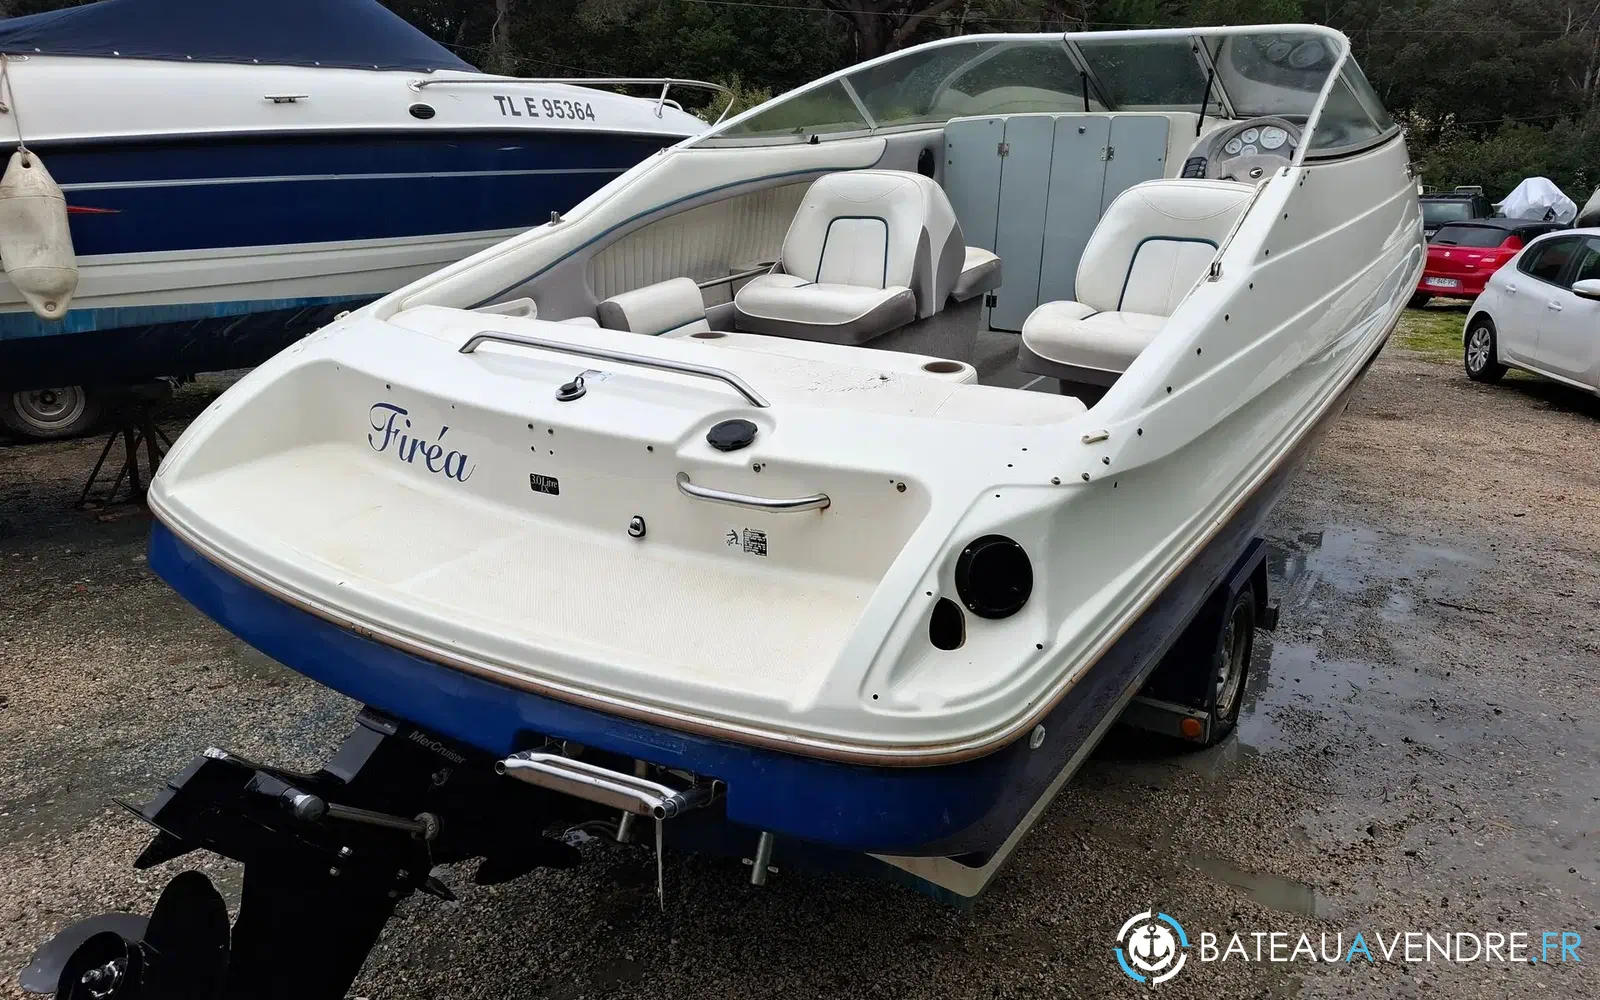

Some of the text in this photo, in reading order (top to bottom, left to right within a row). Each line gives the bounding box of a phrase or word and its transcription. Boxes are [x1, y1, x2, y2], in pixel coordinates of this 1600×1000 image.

[493, 95, 596, 121] TL E 95364
[367, 402, 477, 483] Firéa
[408, 730, 467, 764] MerCruiser
